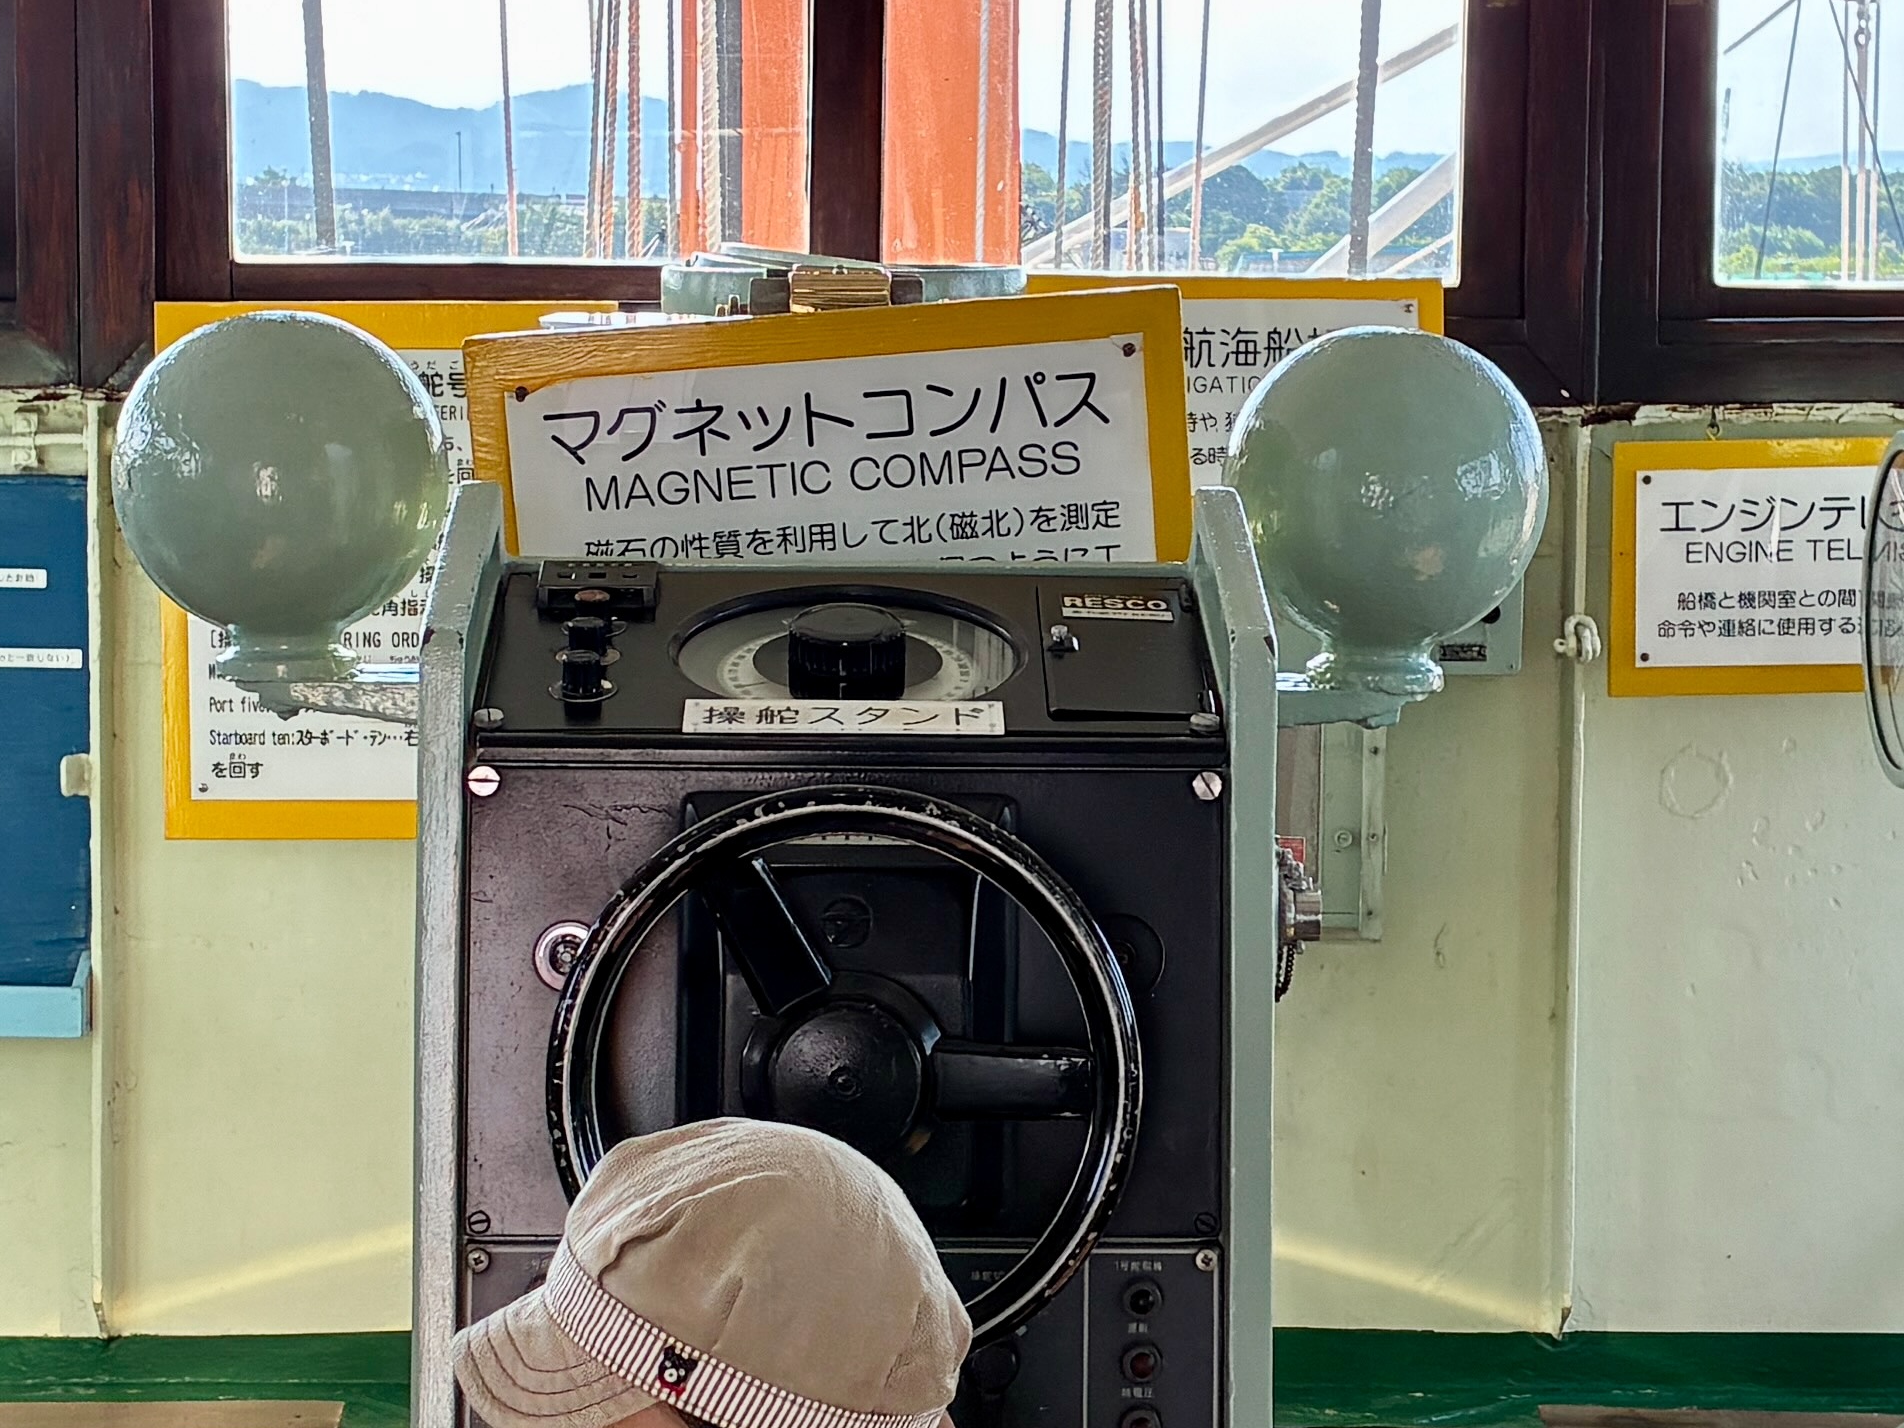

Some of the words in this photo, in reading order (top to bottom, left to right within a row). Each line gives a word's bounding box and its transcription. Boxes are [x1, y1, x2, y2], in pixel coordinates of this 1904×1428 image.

[1183, 327, 1316, 368] 航海船
[542, 371, 1110, 465] マグネットコンパス
[585, 460, 833, 512] MAGNETIC
[849, 440, 1081, 492] COMPASS
[1686, 539, 1794, 563] ENGINE
[1807, 539, 1863, 561] TEL
[1063, 596, 1168, 611] RESCO
[1676, 588, 1863, 611] 船橋と機関室との間
[1657, 616, 1863, 638] 命令や連絡に使用する
[392, 632, 420, 648] ORD
[209, 697, 234, 713] Port
[702, 706, 985, 727] 操舵スタンド
[209, 729, 265, 746] Starboard
[211, 761, 263, 779] を回す
